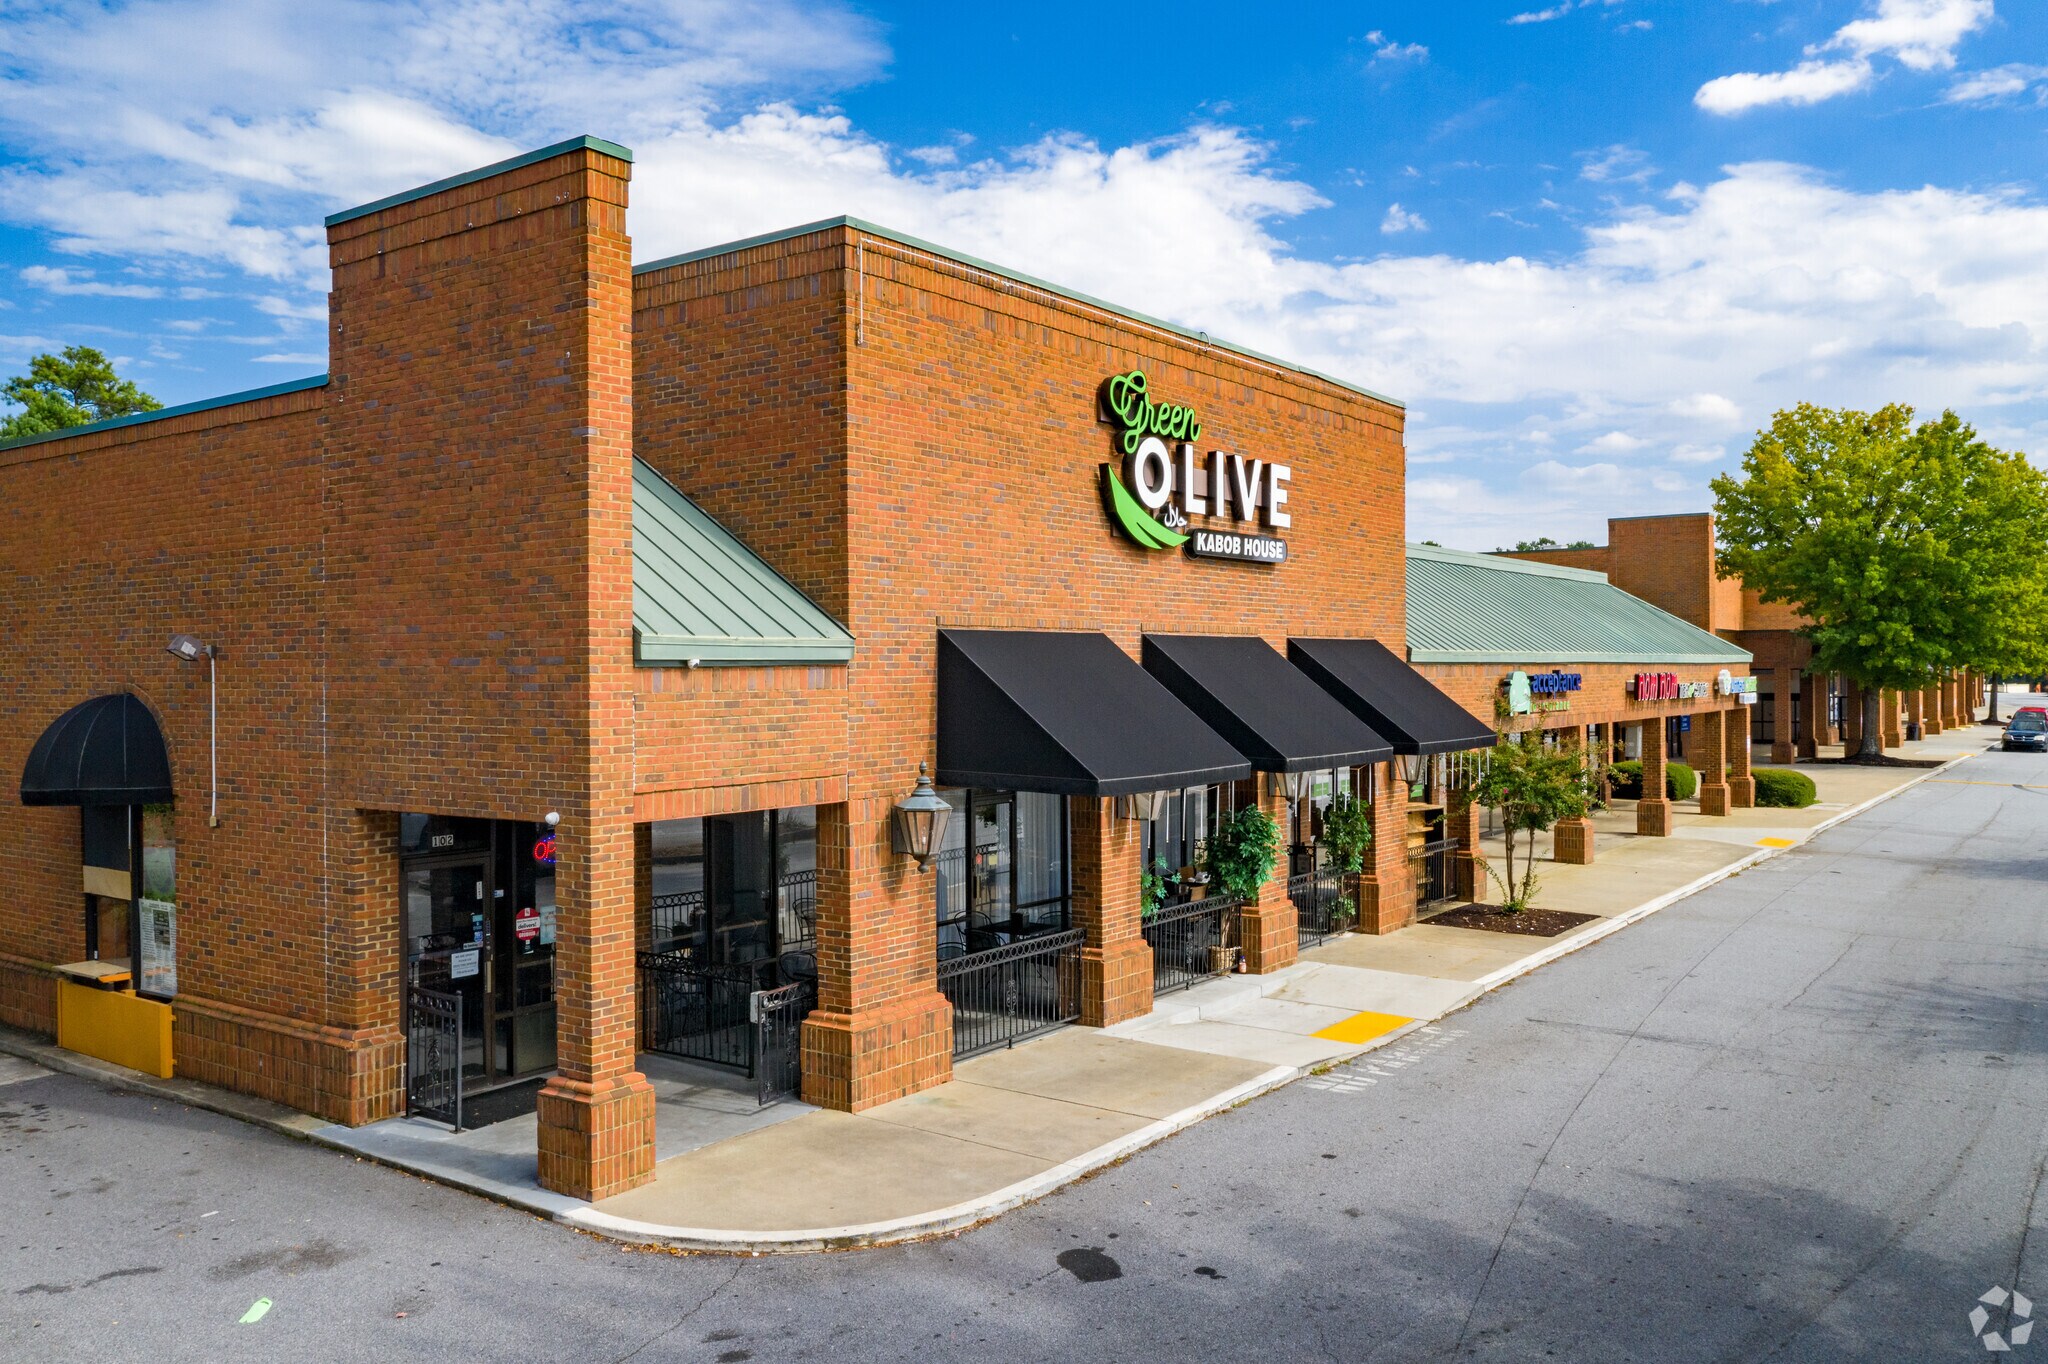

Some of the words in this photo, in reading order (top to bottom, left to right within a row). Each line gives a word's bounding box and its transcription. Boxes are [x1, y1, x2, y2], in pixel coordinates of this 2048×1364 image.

[1110, 370, 1201, 453] Green
[1134, 437, 1291, 529] OLIVE
[1197, 532, 1241, 555] KABOB
[1244, 538, 1284, 559] HOUSE
[1532, 673, 1582, 699] acceptance
[433, 835, 453, 847] 102
